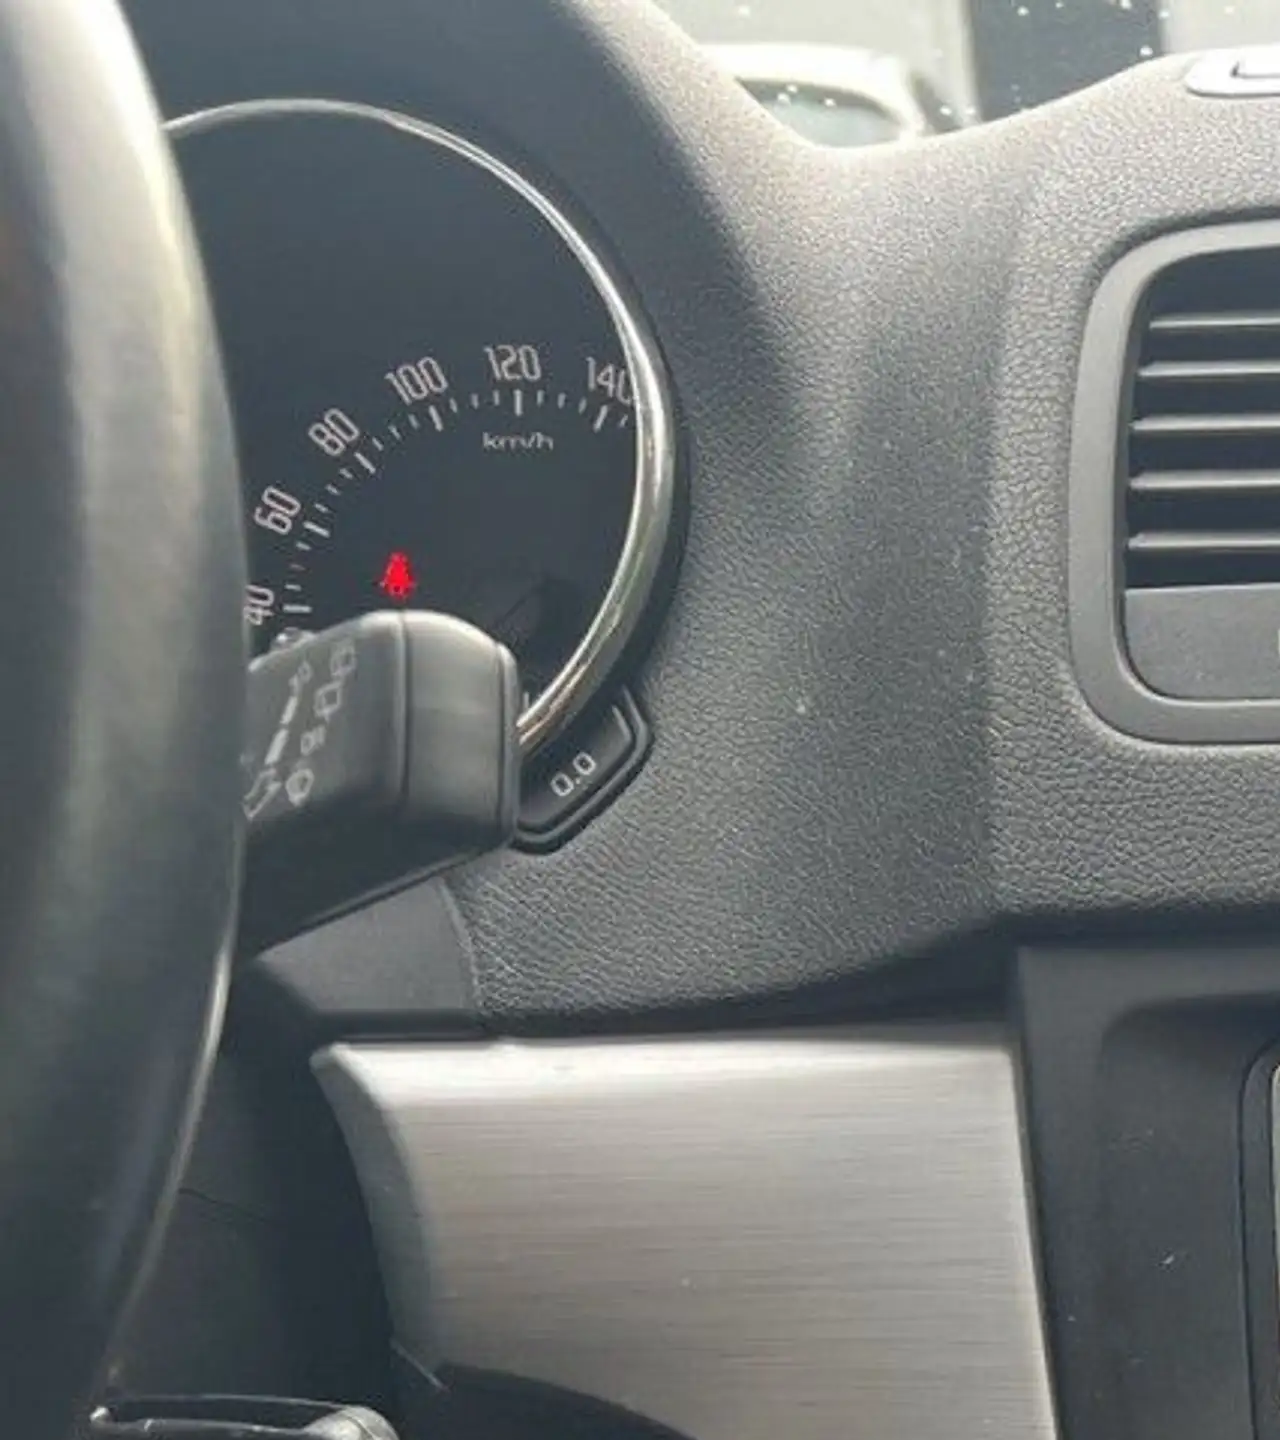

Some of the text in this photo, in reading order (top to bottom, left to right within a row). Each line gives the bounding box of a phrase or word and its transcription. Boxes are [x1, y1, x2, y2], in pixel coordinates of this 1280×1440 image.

[384, 356, 448, 405] 100
[484, 345, 541, 381] 120
[308, 408, 359, 456] 80
[483, 431, 555, 450] km/h
[254, 488, 302, 535] 60
[244, 584, 275, 626] 40
[550, 752, 596, 796] 0.0
